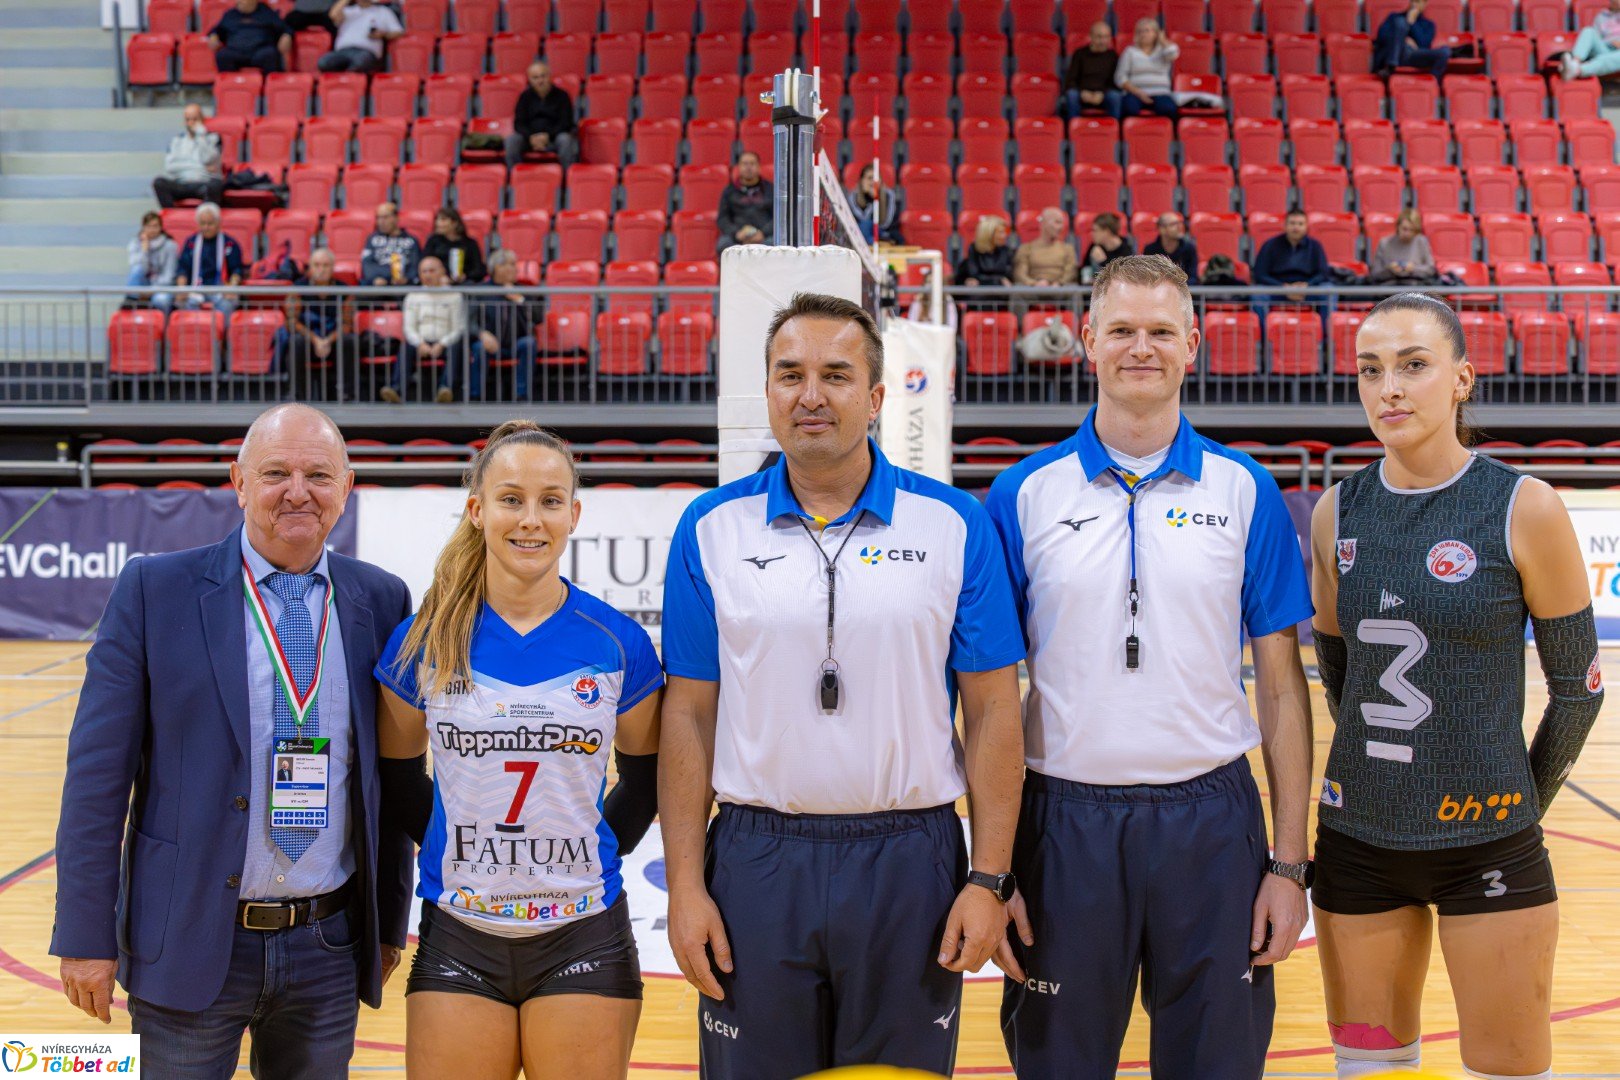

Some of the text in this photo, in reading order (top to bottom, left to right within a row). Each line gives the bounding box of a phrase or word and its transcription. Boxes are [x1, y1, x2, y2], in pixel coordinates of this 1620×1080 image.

[1192, 513, 1229, 528] CEV
[1438, 541, 1460, 549] IGMAN
[887, 549, 927, 562] CEV
[1357, 619, 1433, 730] 3
[504, 761, 540, 824] 7
[452, 821, 592, 866] FATUM
[453, 863, 593, 876] PROPERTY
[1482, 869, 1507, 898] 3
[491, 895, 594, 920] Többet ad!
[1027, 978, 1061, 995] CEV
[715, 1020, 739, 1040] CEV
